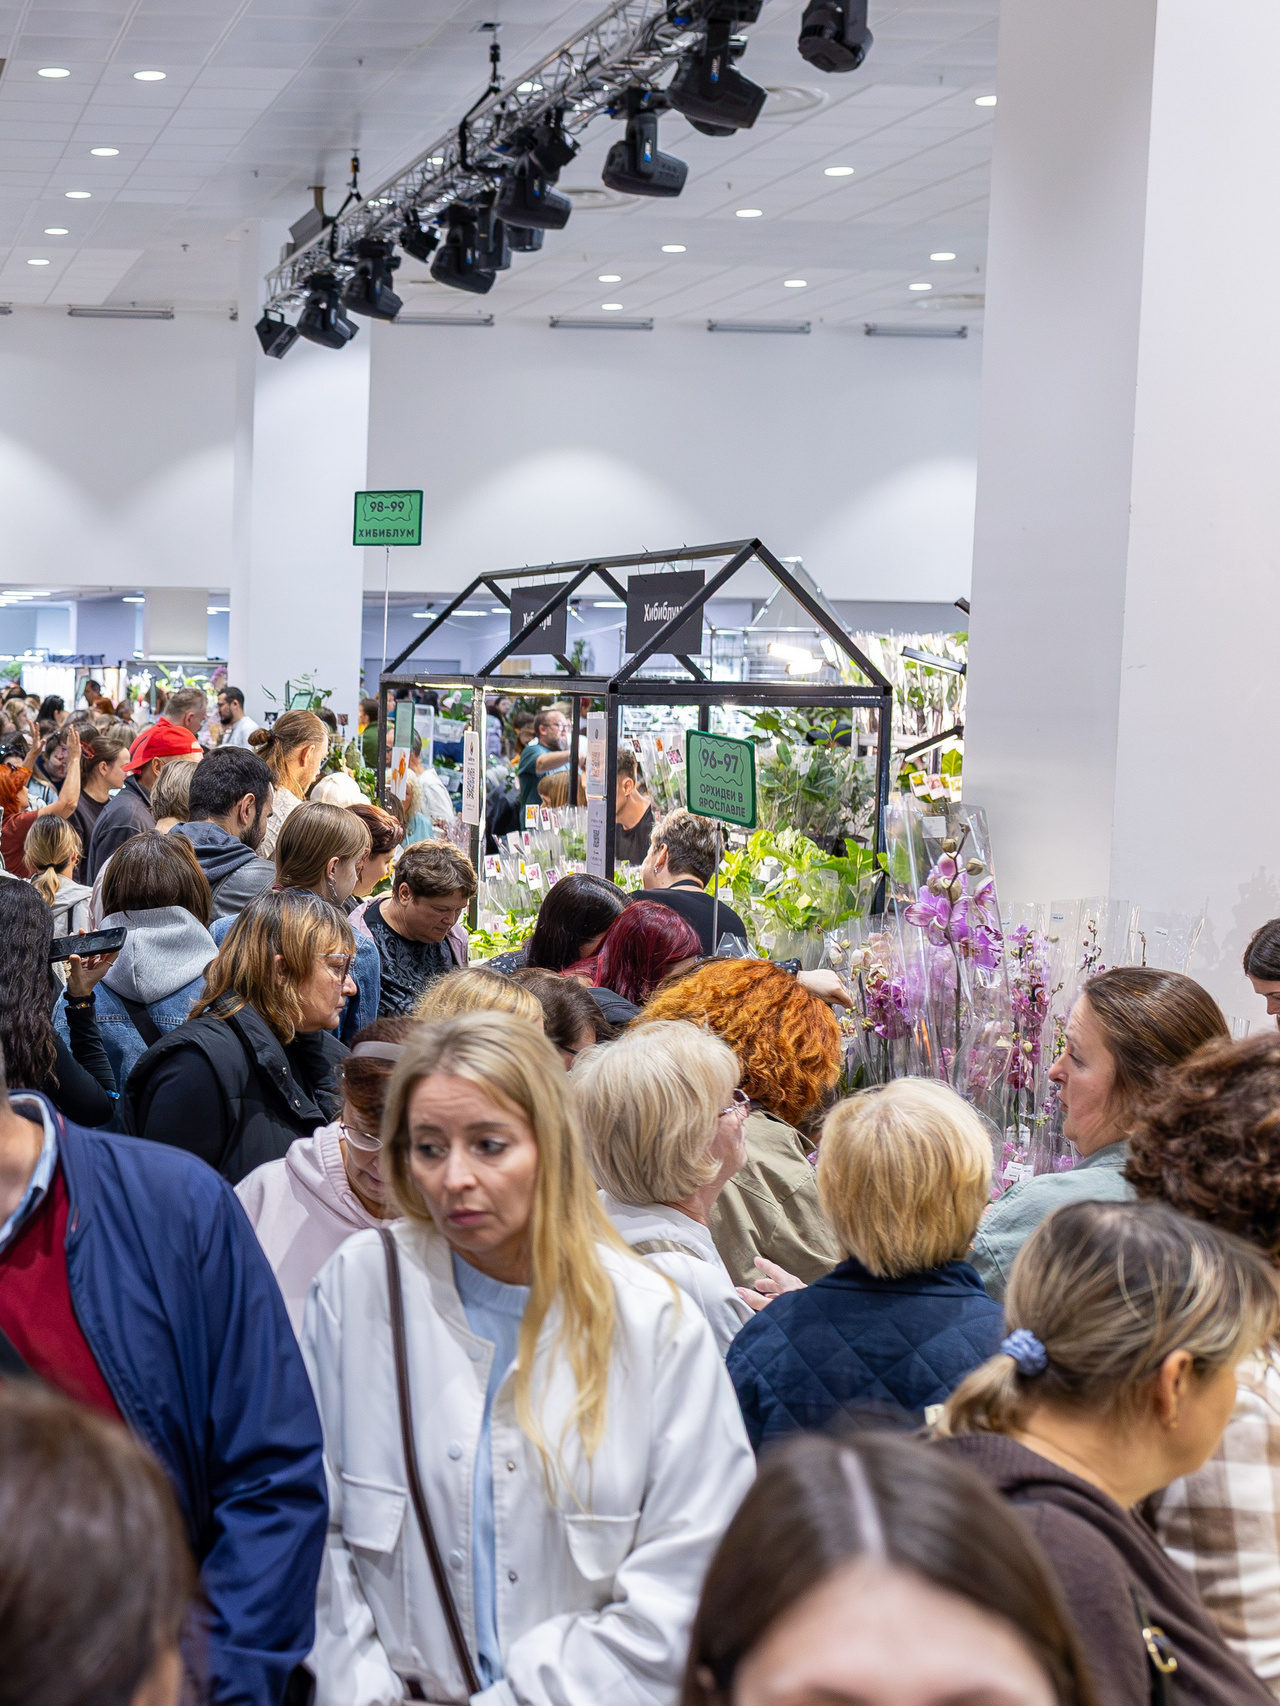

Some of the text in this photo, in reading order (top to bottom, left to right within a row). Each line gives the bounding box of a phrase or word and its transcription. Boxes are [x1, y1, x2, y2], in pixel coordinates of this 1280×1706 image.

[369, 500, 405, 513] 98-99
[358, 528, 415, 538] ХИБИБЛУМ
[701, 748, 739, 774] 96-97
[700, 783, 743, 803] ОРХИДЕИ В
[699, 797, 746, 818] ЯРОСЛАВЛЕ
